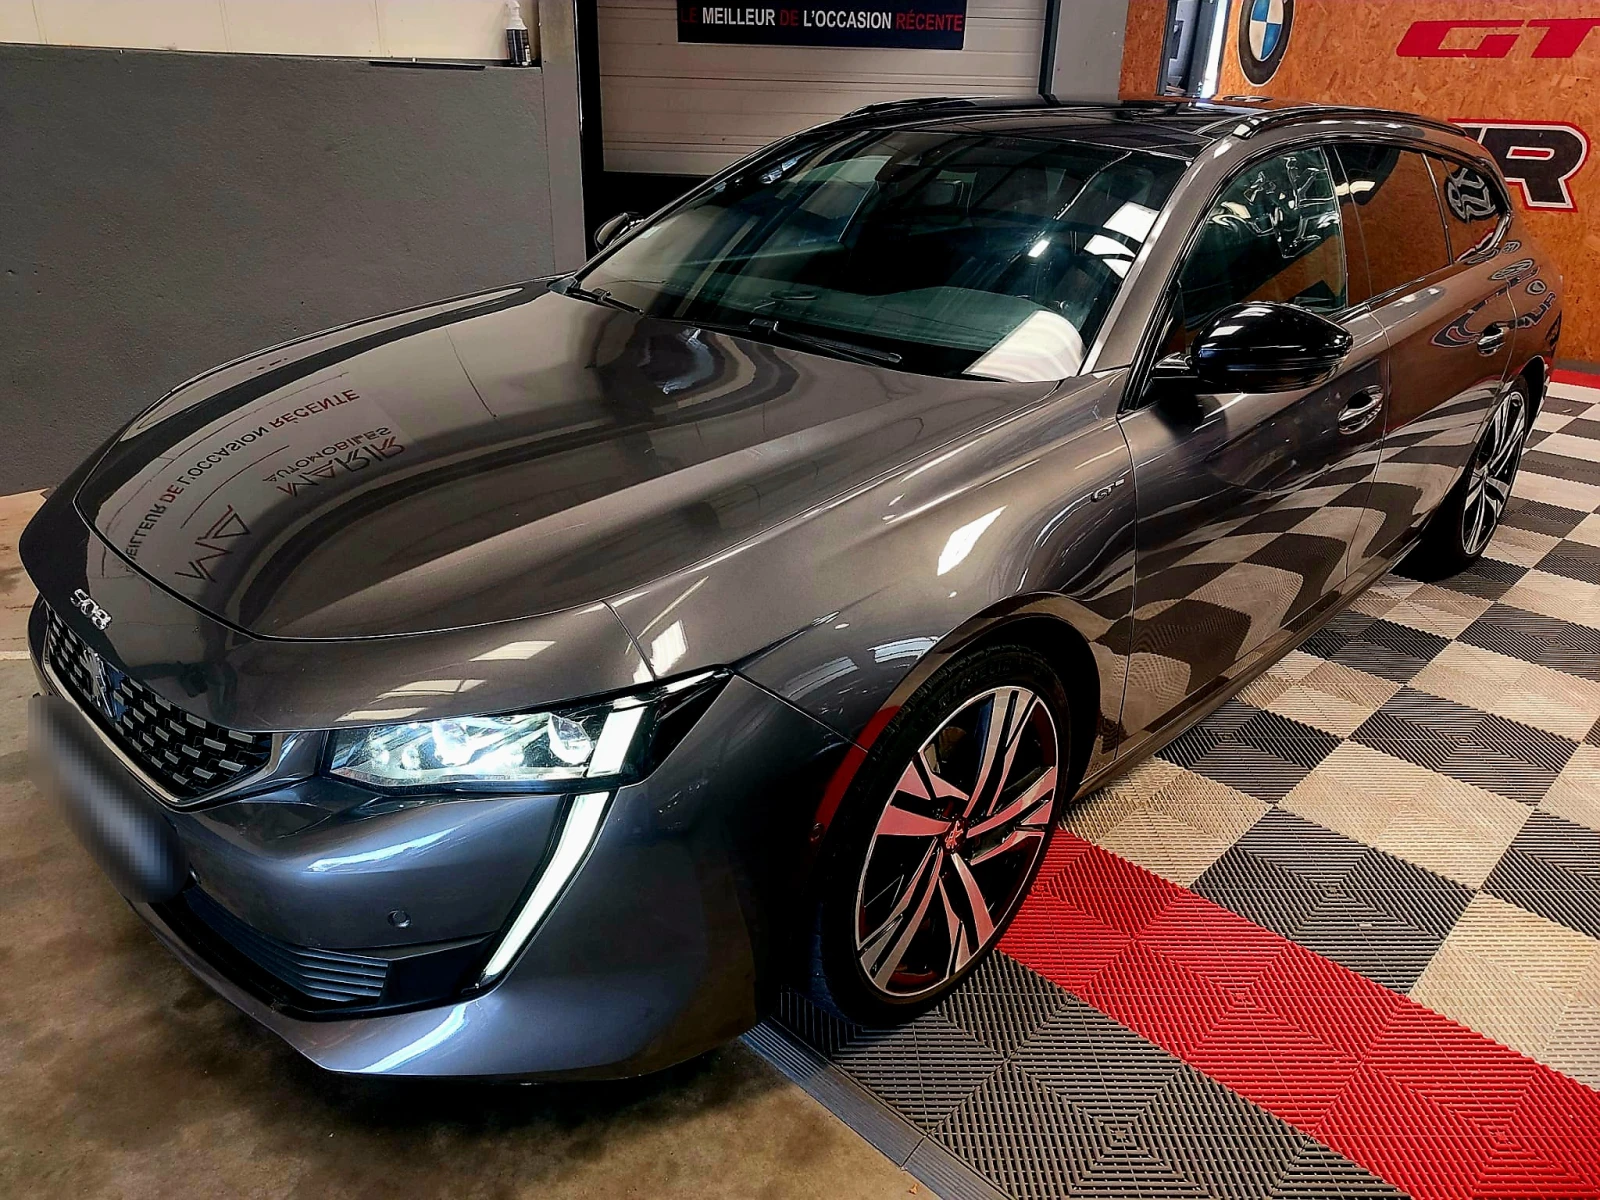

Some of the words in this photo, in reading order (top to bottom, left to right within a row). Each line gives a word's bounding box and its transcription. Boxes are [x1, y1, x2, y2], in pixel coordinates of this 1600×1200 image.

[680, 7, 698, 23] LE
[702, 7, 776, 26] MEILLEUR
[779, 9, 799, 26] DE
[803, 10, 892, 29] L'OCCASION
[895, 9, 964, 32] RÉCENTE
[1448, 118, 1591, 213] R
[70, 588, 112, 631] 508
